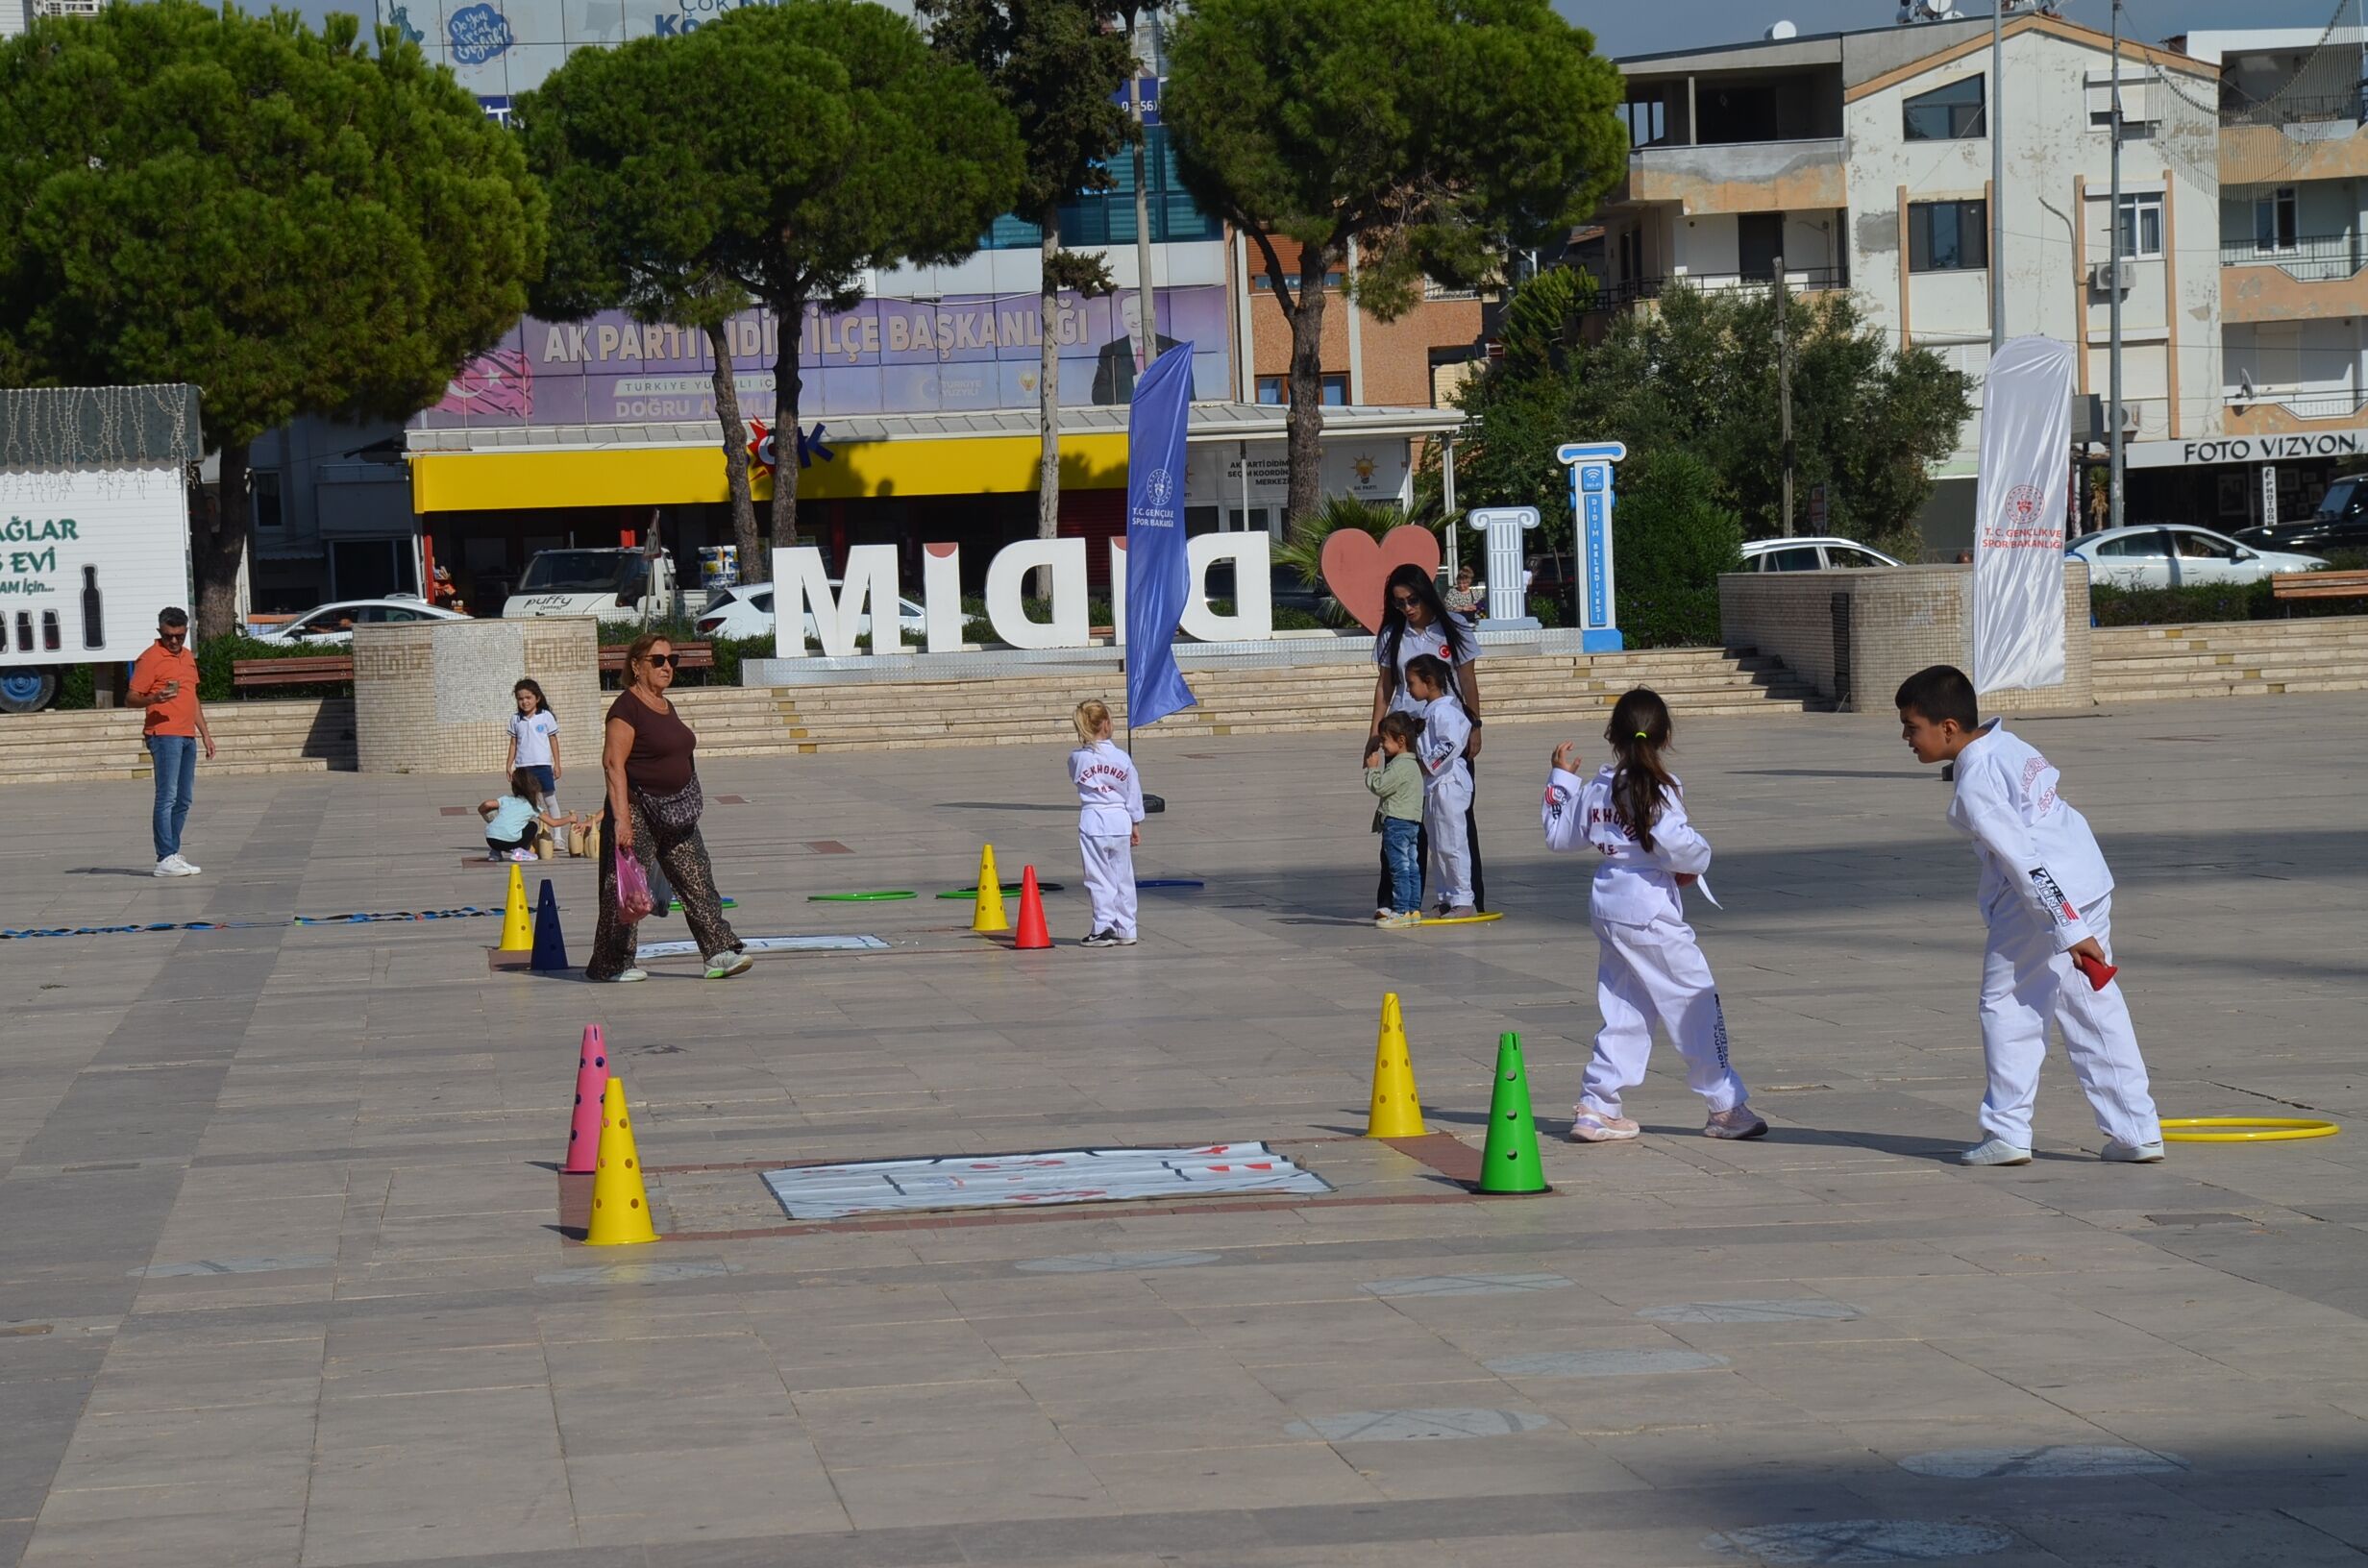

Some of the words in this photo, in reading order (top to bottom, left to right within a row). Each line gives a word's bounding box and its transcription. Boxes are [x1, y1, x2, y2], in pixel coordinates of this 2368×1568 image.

[544, 326, 592, 363] AK
[811, 306, 880, 363] İLÇE
[888, 299, 1088, 359] BAŞKANLĞI
[616, 397, 690, 418] DOĞRU
[2184, 439, 2251, 463] FOTO
[2259, 433, 2356, 457] VIZYON
[1246, 459, 1266, 468] ARTİ
[1254, 468, 1289, 478] KOORDİN
[1132, 517, 1149, 527] SPOR
[1982, 539, 2009, 549] SPOR
[10, 545, 57, 574] EVİ
[523, 595, 573, 609] puffy
